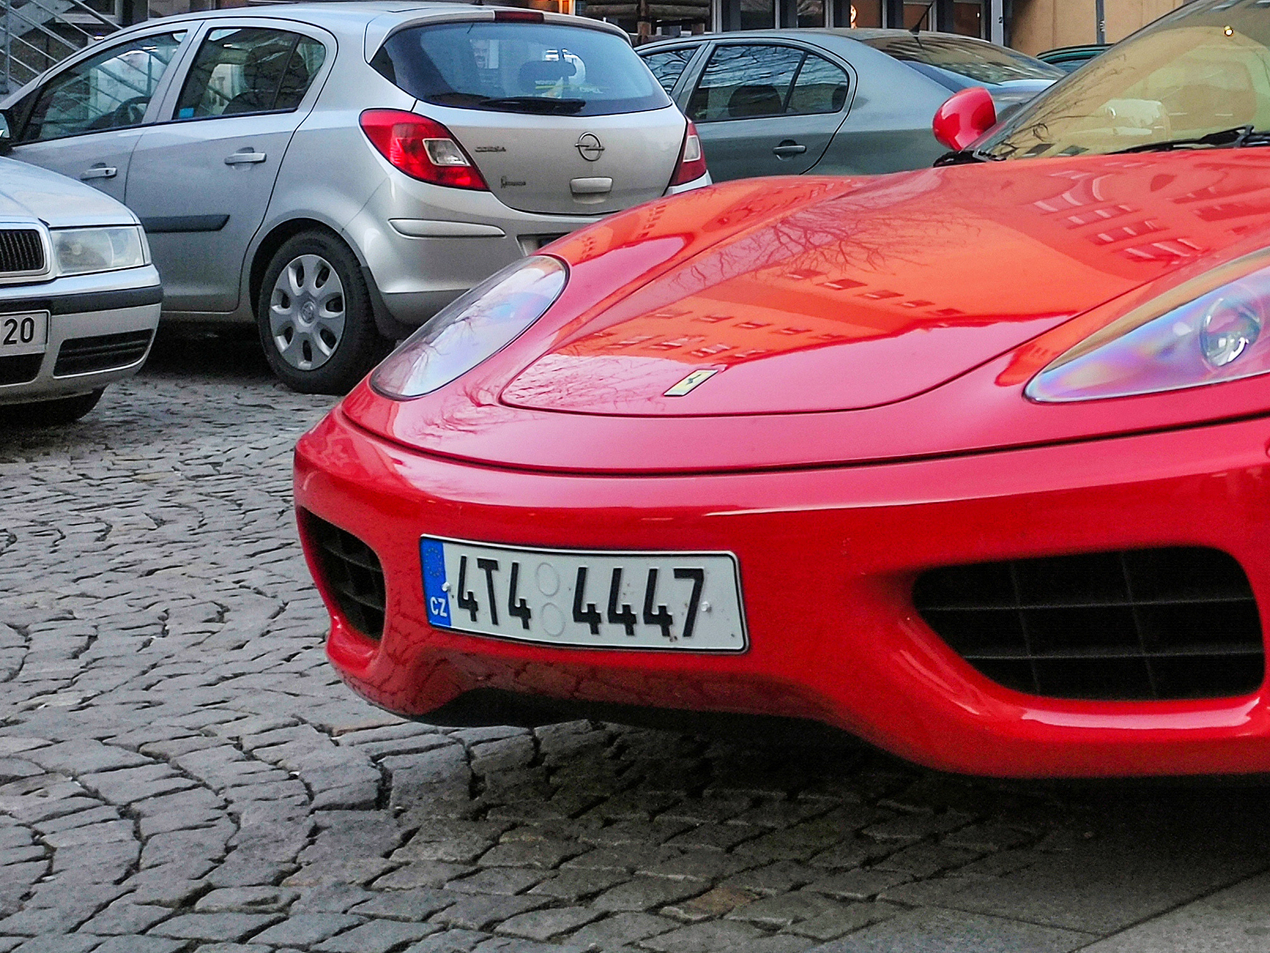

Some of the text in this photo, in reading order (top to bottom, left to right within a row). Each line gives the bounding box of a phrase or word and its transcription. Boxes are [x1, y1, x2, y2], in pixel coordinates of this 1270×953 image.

[430, 596, 448, 618] CZ
[457, 554, 705, 637] 4T4 4447
